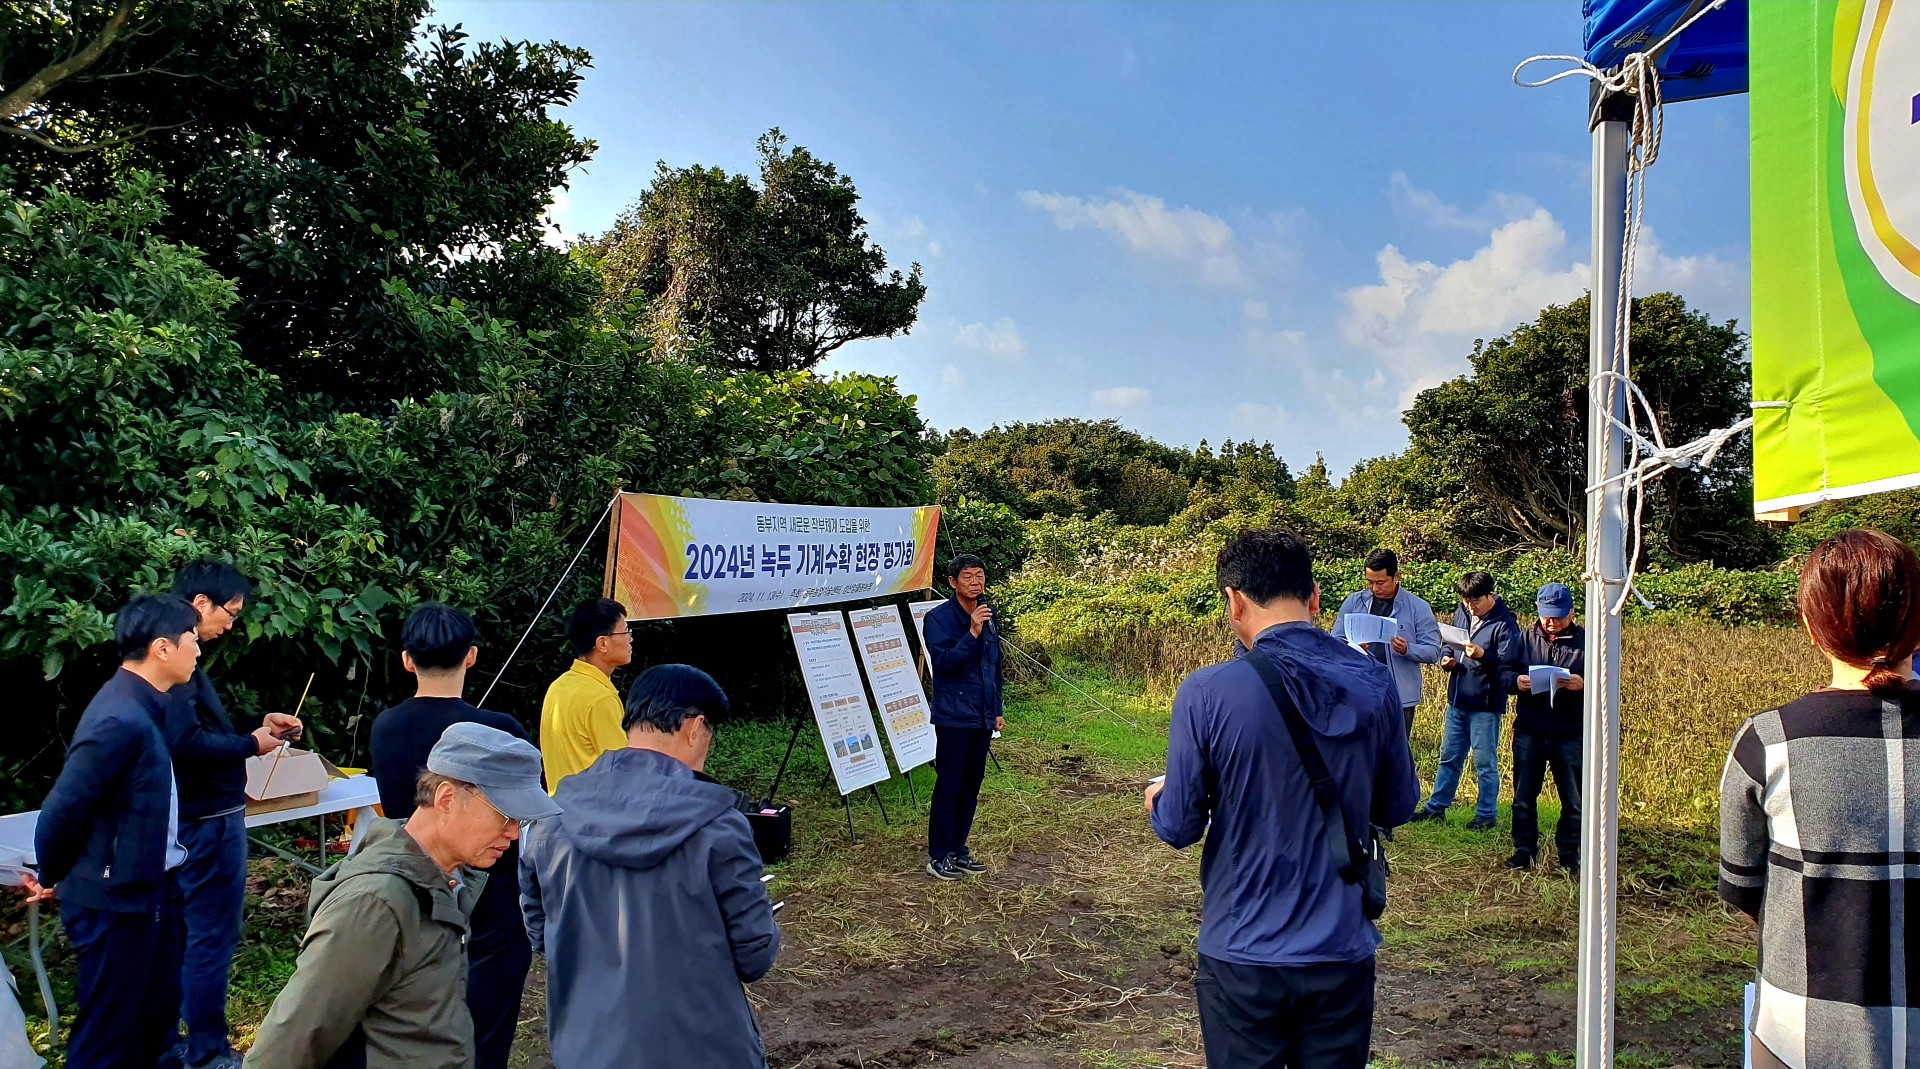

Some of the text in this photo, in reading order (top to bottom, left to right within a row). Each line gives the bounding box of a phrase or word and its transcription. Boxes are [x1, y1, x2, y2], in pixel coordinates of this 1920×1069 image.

[756, 515, 871, 534] 동부지역 새로운 작부체계 도입을 위한
[684, 539, 916, 580] 2024년 녹두 기계수확 현장 평가회
